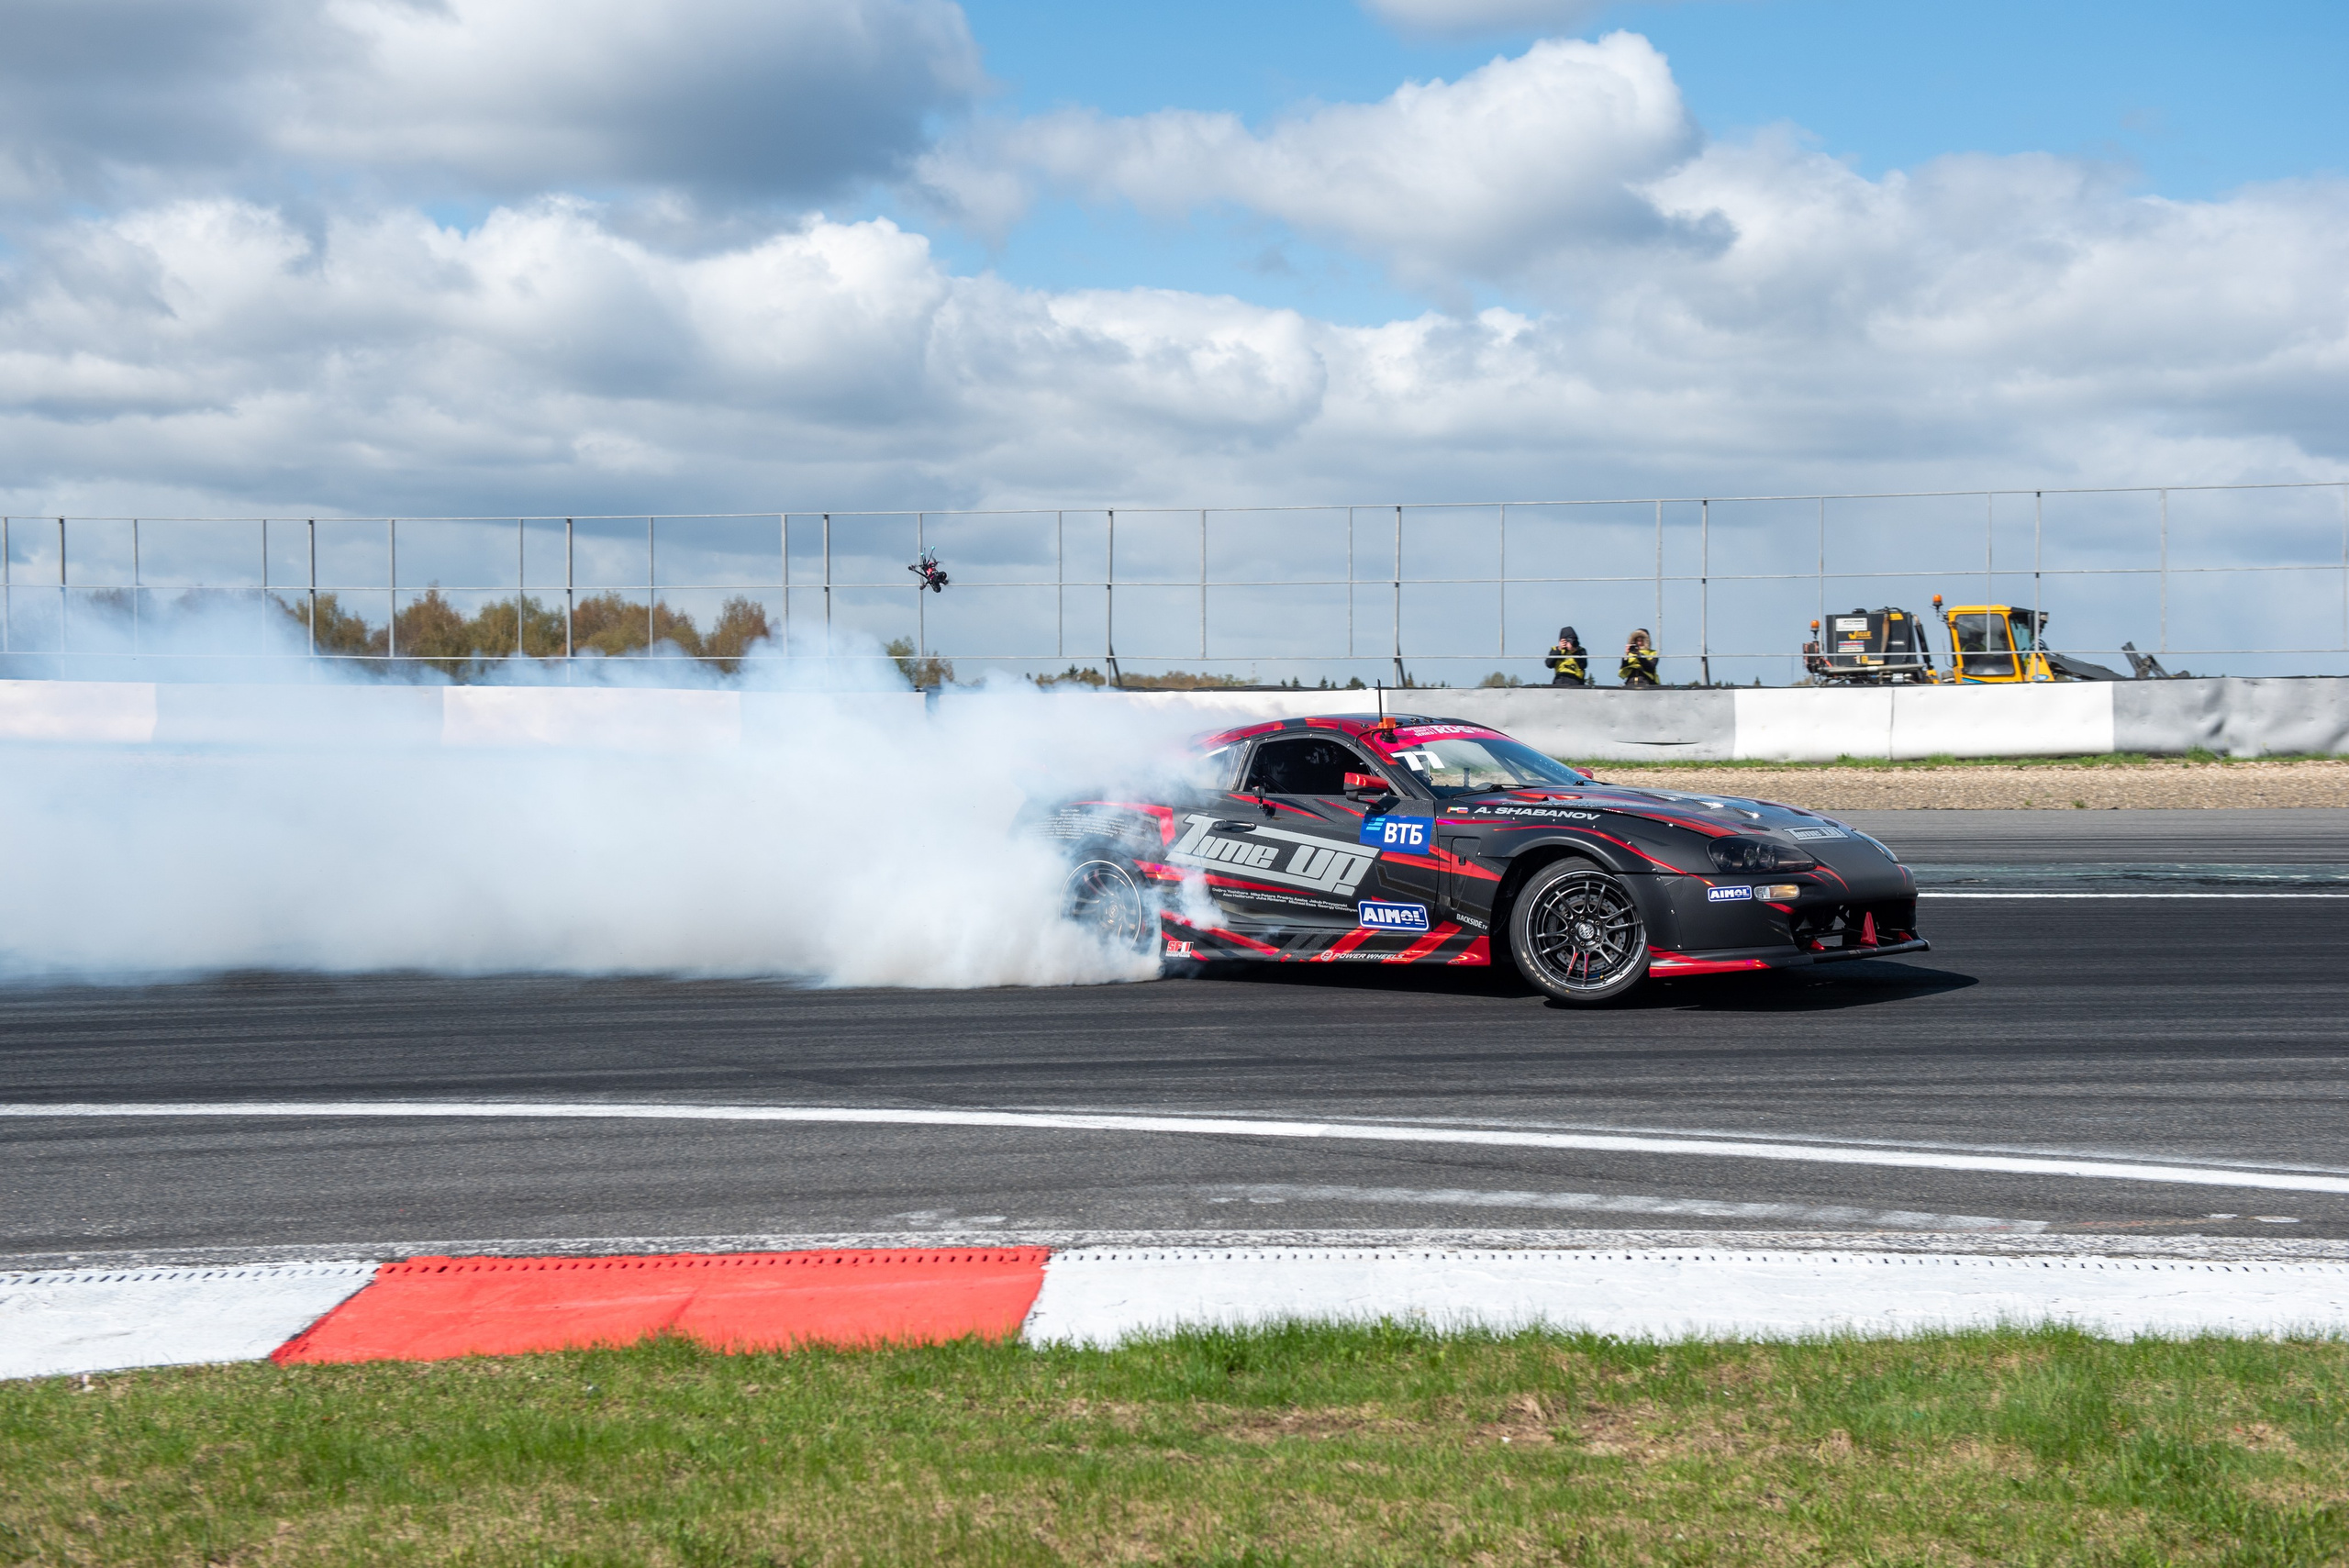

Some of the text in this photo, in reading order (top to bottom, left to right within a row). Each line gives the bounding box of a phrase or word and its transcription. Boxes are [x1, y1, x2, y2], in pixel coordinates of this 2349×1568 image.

[1430, 725, 1474, 734] RDS
[1389, 751, 1445, 771] 77
[1494, 806, 1601, 820] SHABANOV
[1384, 822, 1424, 845] ВТБ
